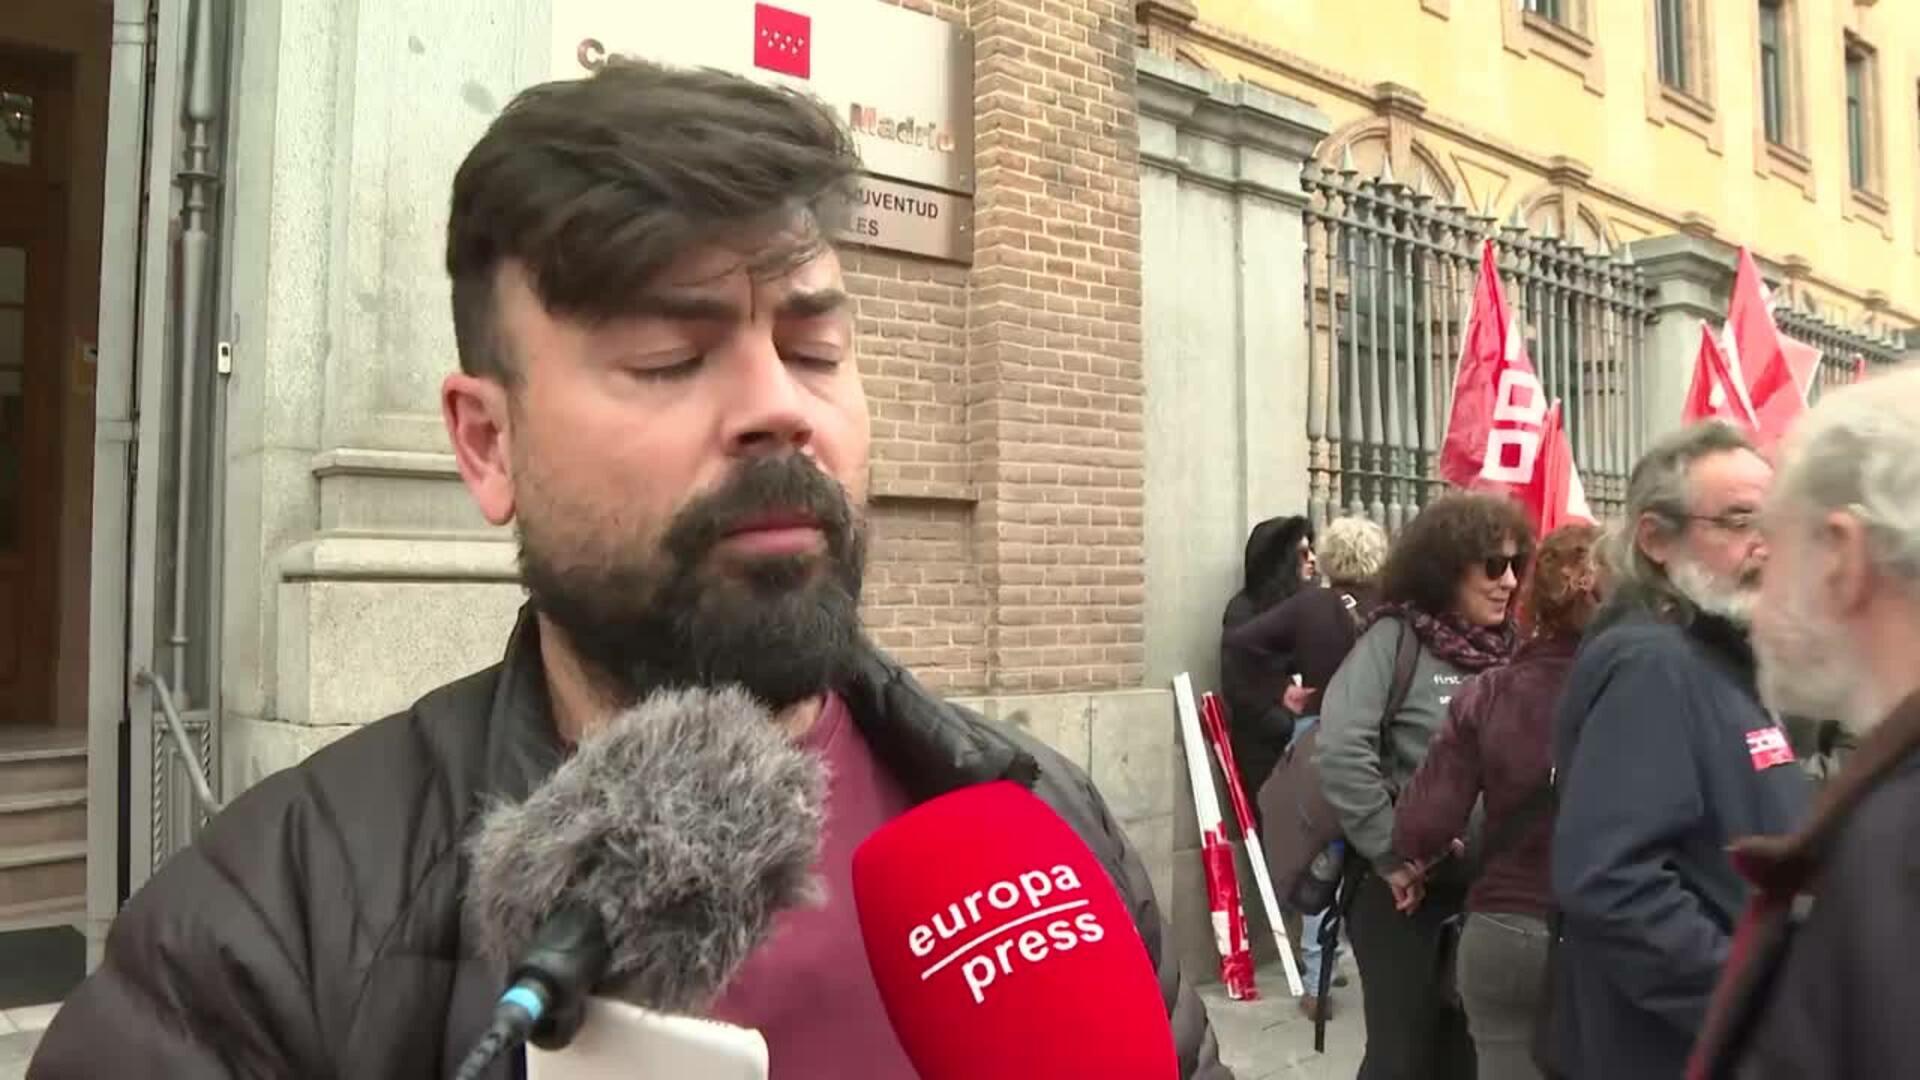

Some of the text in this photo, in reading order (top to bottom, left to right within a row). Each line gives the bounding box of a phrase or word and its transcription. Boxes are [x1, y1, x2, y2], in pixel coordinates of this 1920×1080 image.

[857, 187, 939, 219] UVENTUD
[908, 864, 1082, 957] europa
[961, 912, 1104, 1004] press
